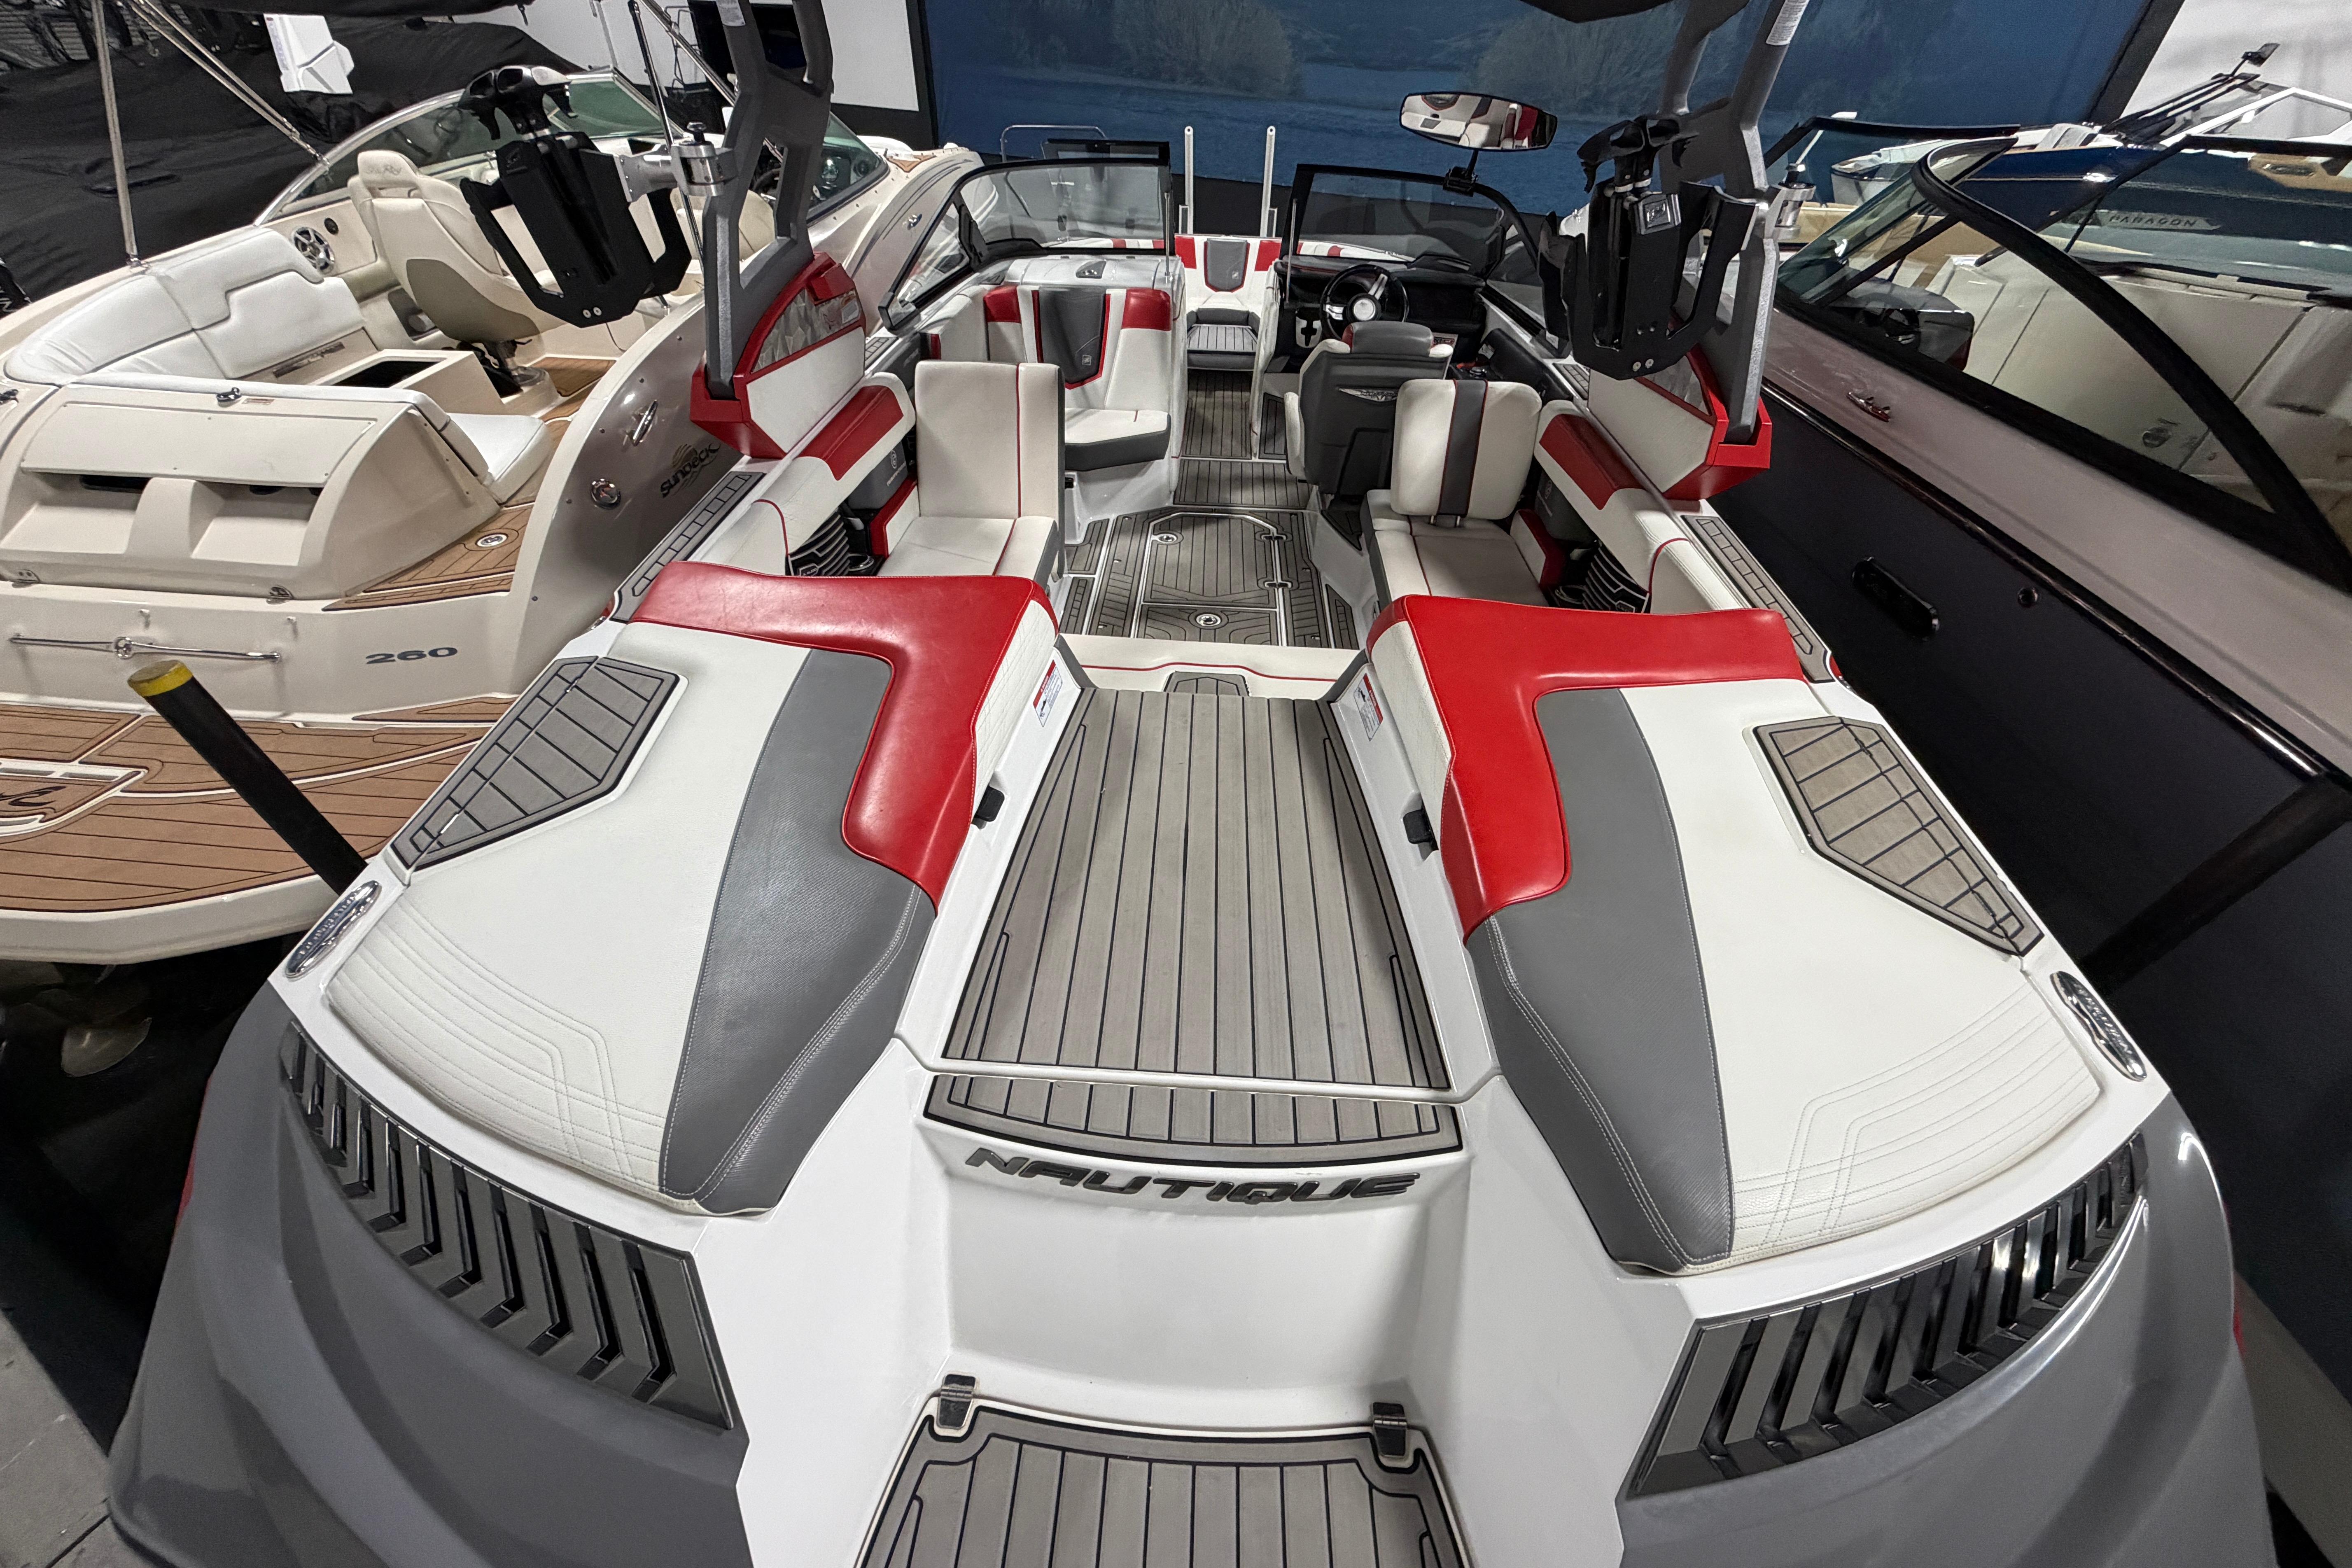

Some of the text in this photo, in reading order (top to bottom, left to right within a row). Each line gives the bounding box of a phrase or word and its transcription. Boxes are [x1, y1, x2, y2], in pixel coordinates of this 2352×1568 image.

[2109, 214, 2197, 227] PARAGON
[366, 647, 458, 664] 260
[965, 1147, 1421, 1205] NAUTIQUE
